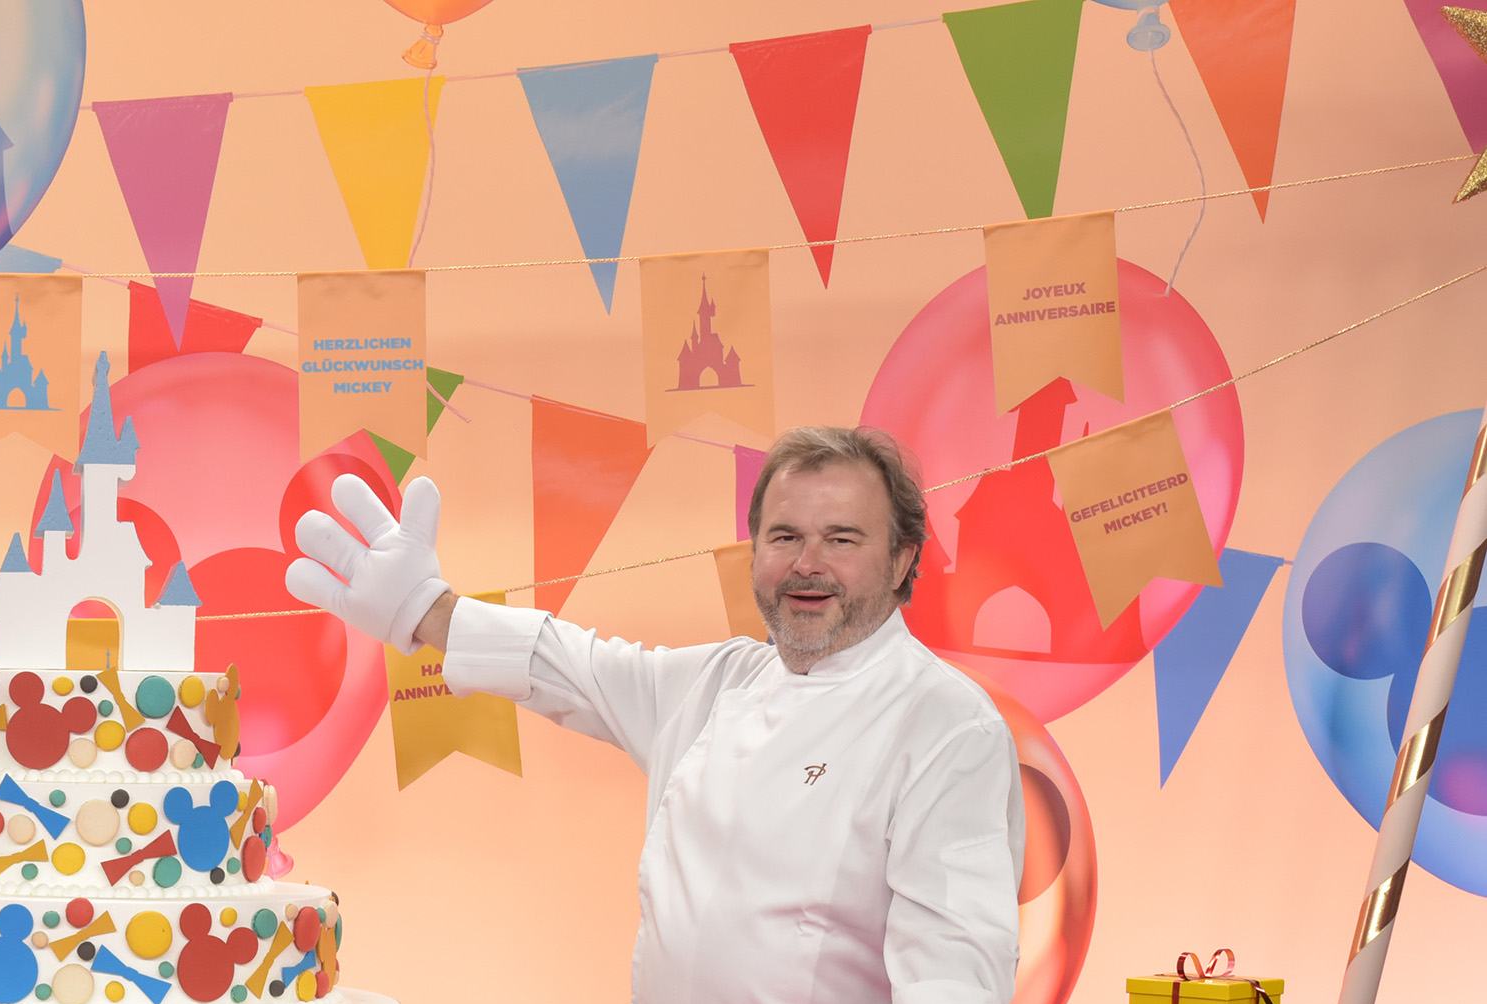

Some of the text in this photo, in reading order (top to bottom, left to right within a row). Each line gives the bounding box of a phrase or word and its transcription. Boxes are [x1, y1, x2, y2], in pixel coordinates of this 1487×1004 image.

[1022, 282, 1086, 301] JOYEUX
[994, 301, 1116, 326] ANNIVERSAIRE
[313, 337, 412, 351] HERZLICHEN
[301, 358, 425, 373] GLÜCKWUNSCH
[334, 381, 392, 394] MICKEY
[1070, 472, 1189, 523] GEFELICITEERD
[1103, 502, 1168, 535] MICKEY!
